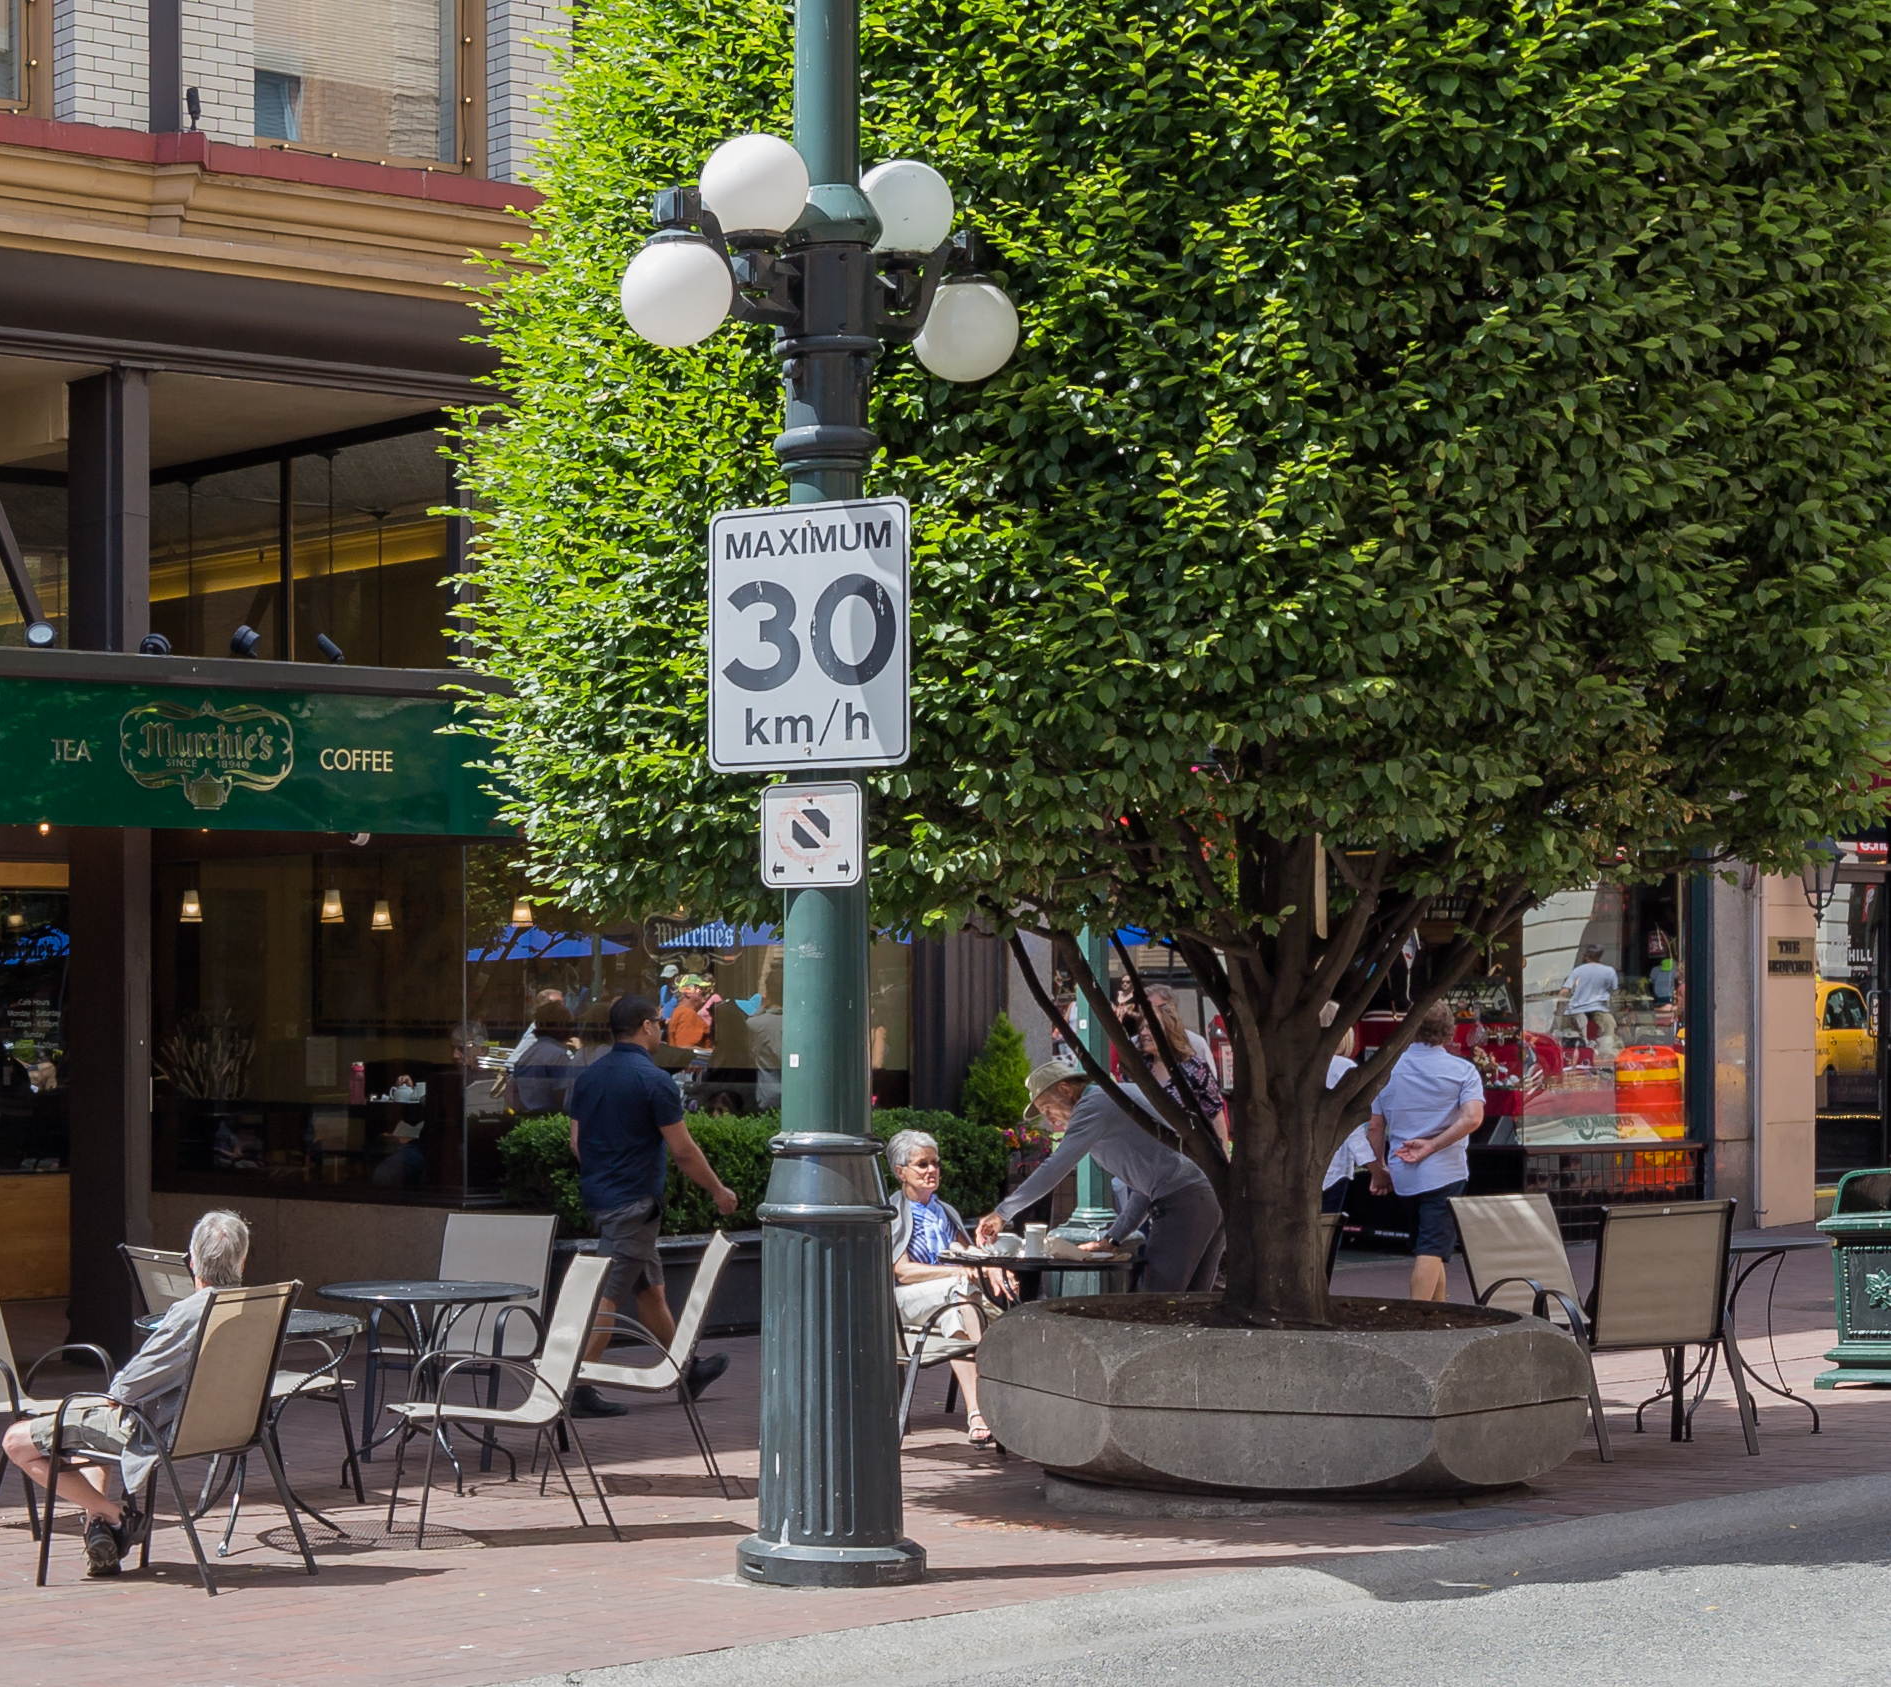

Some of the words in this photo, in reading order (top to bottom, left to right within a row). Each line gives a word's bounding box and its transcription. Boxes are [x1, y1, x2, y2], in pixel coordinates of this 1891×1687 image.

[725, 520, 892, 561] MAXIMUM
[721, 573, 897, 692] 30
[744, 698, 870, 747] km/h
[50, 738, 93, 762] TEA
[137, 721, 275, 761] Murchie's
[319, 748, 394, 773] COFFEE
[165, 758, 198, 769] SINCE
[654, 922, 736, 948] Murchie's
[1777, 940, 1801, 955] THE
